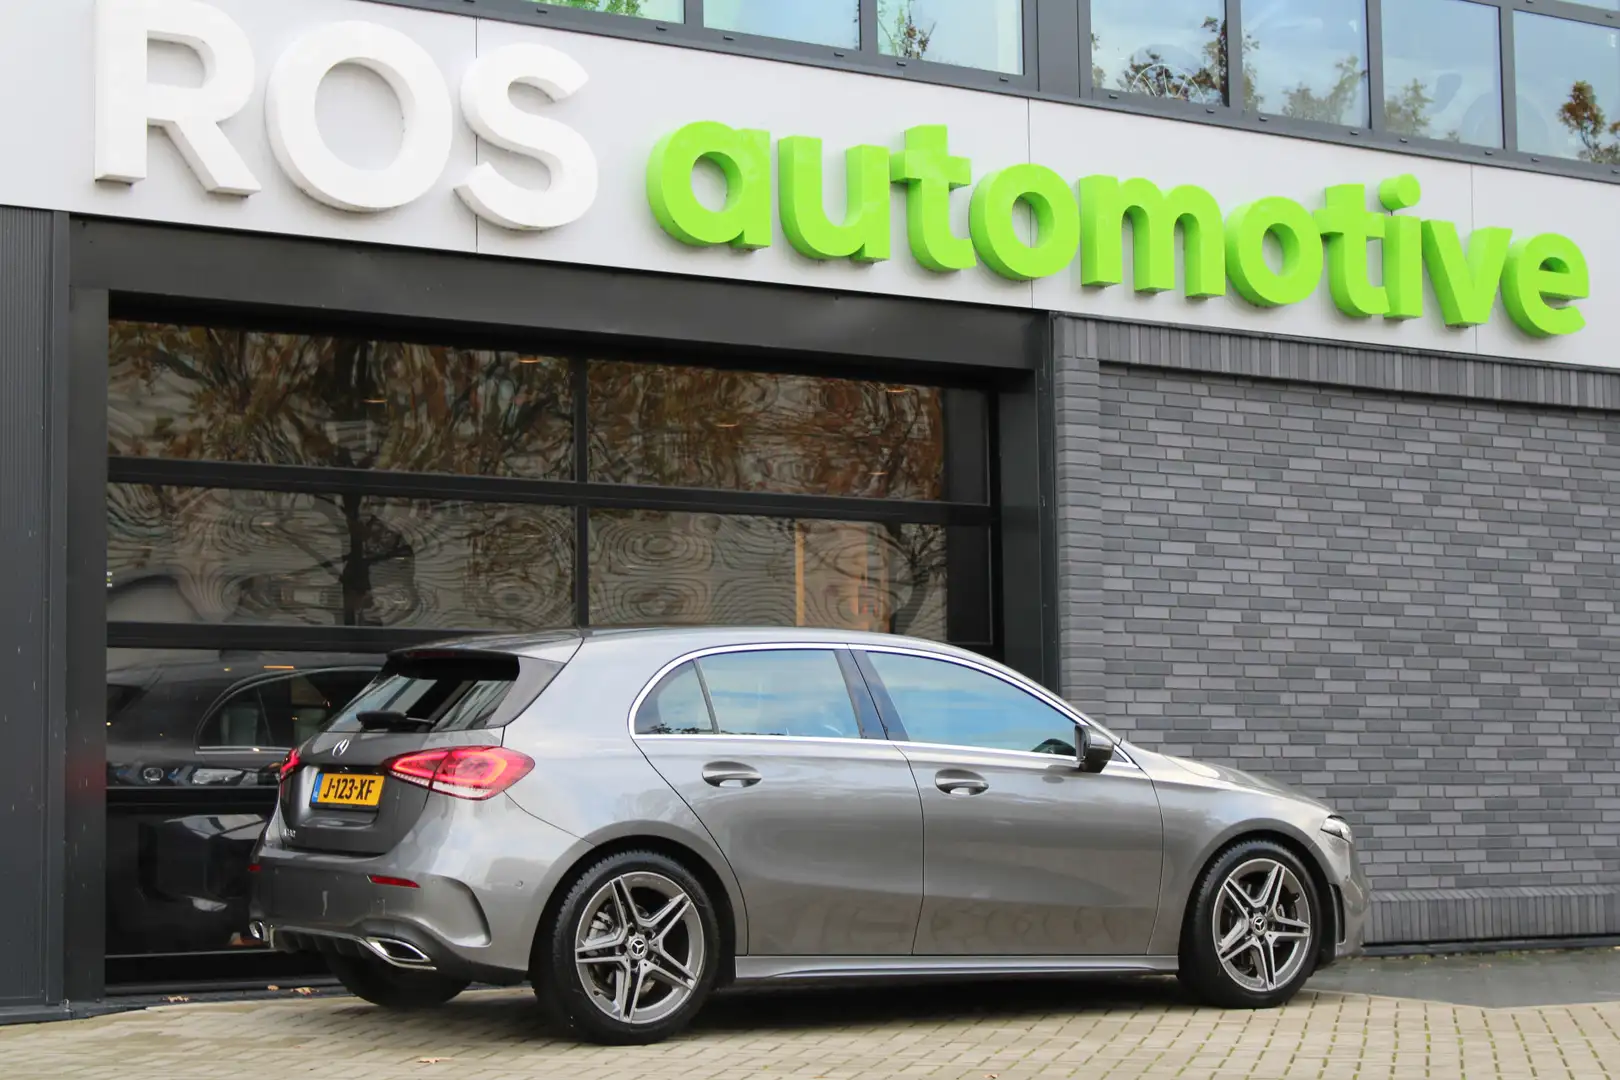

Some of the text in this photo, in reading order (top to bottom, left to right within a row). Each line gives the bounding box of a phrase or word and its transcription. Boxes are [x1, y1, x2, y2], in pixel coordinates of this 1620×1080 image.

[95, 0, 1588, 337] ROS automotive
[322, 777, 376, 801] J-123-XF
